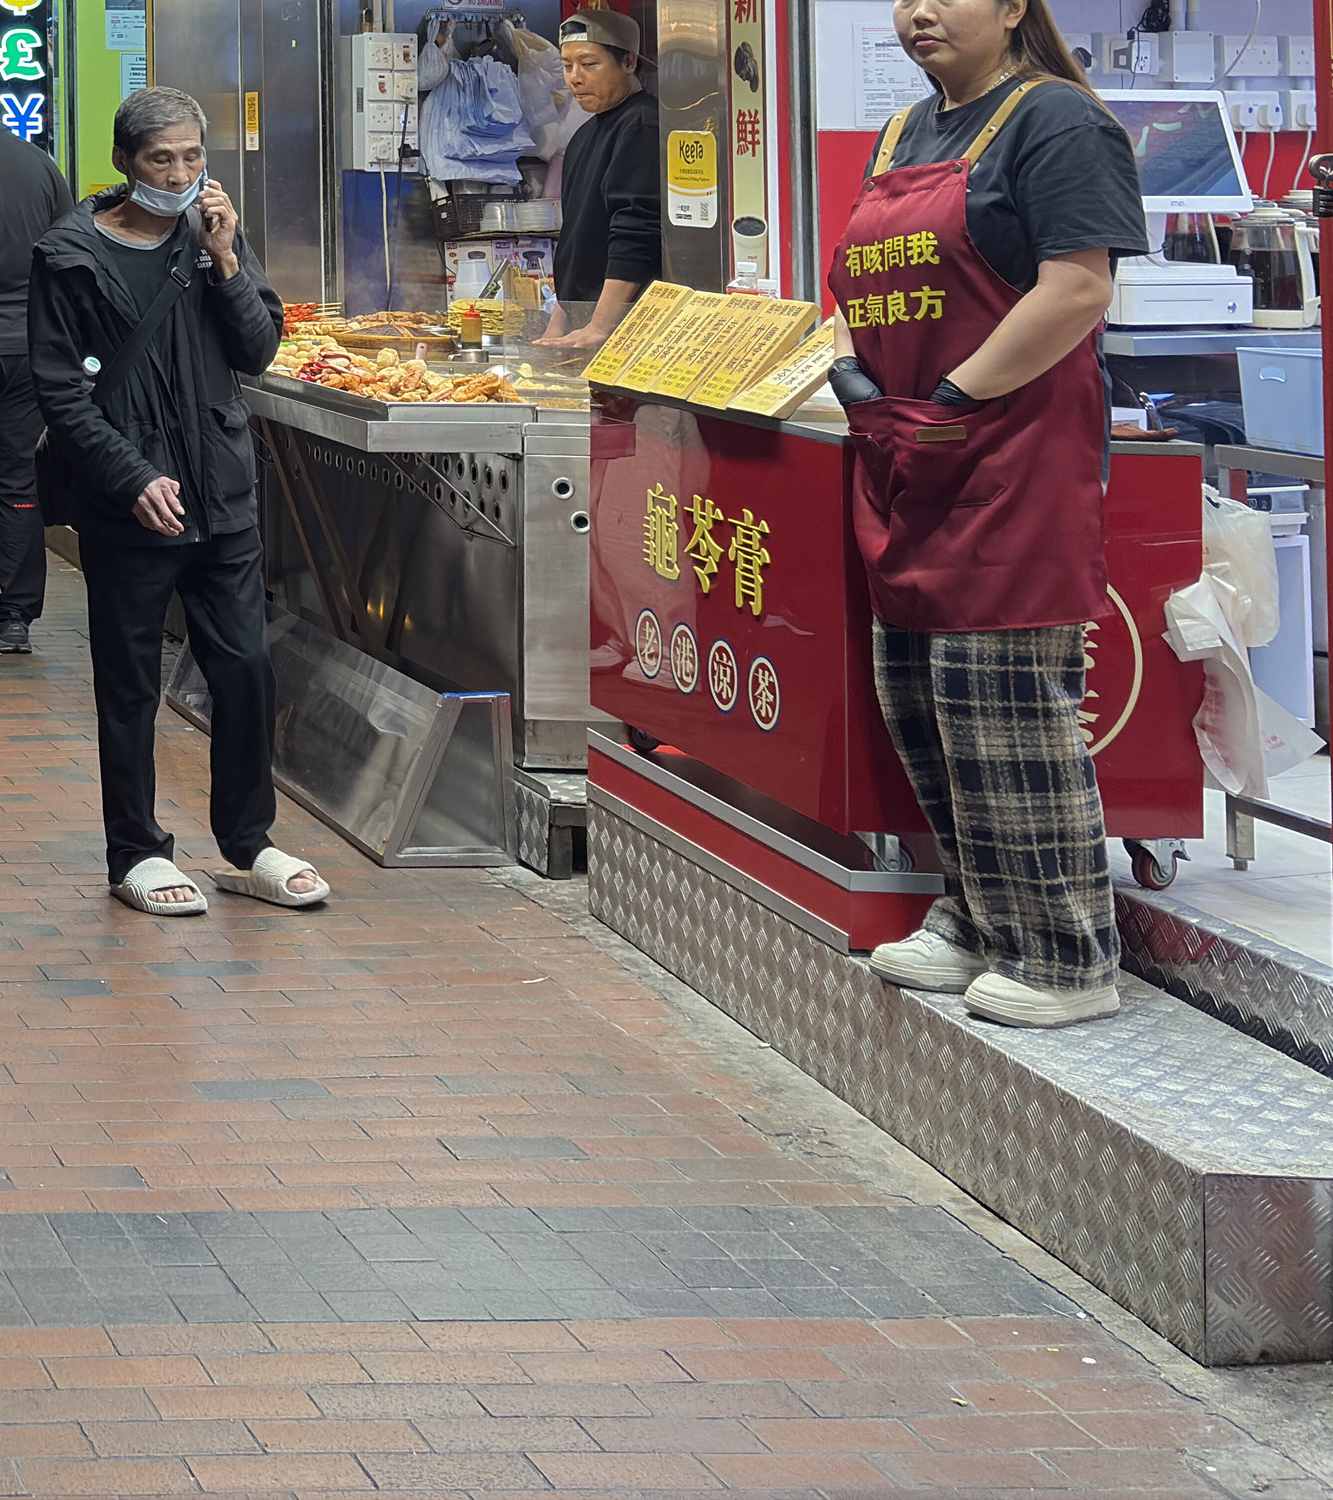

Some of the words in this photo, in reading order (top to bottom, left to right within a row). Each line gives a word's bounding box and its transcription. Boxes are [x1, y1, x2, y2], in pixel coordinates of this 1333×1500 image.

[845, 231, 940, 277] 有咳問我
[847, 286, 946, 328] 正氣良方
[643, 482, 770, 616] 龜苓膏
